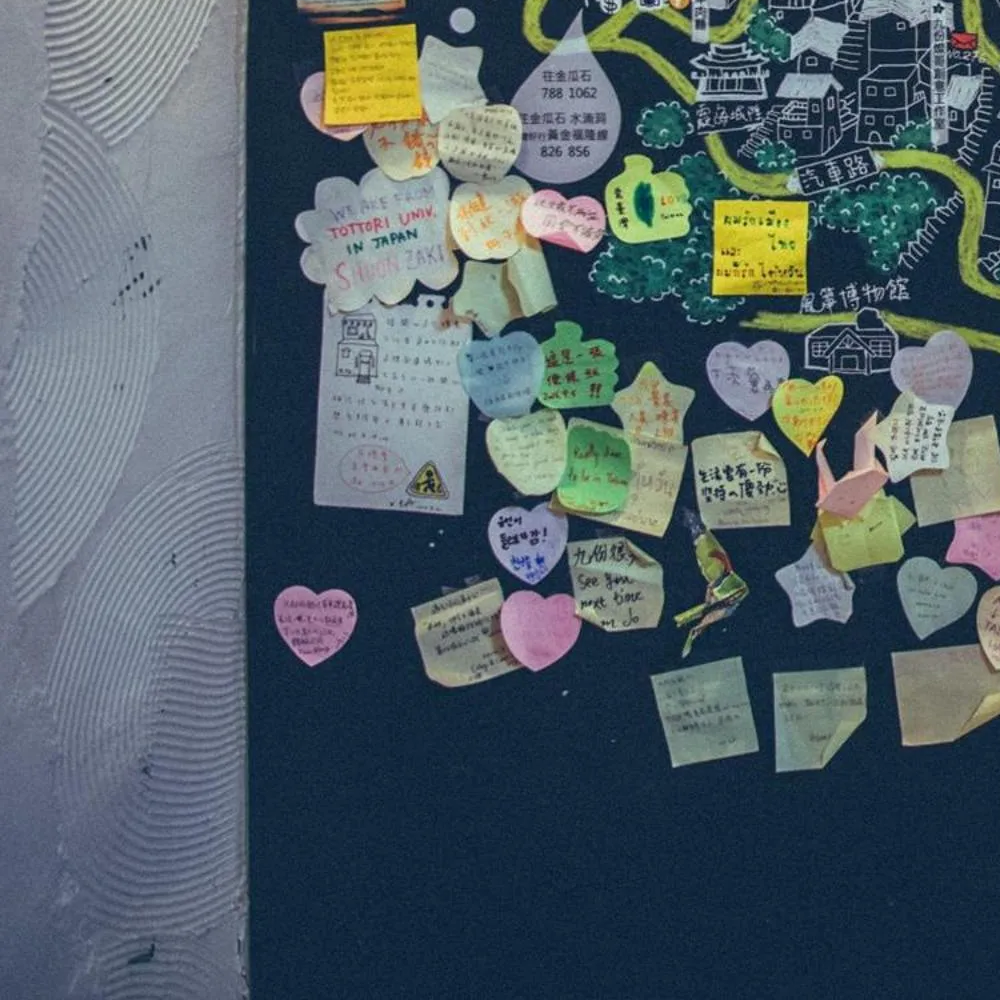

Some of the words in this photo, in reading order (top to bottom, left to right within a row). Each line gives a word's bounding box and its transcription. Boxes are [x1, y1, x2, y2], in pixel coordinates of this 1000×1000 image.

[542, 87, 564, 99] 788
[569, 87, 598, 99] 1062
[541, 146, 563, 158] 826
[568, 146, 590, 158] 856
[802, 153, 869, 190] 汽車路
[327, 215, 389, 239] TOTTORI
[347, 243, 363, 256] IN
[373, 229, 418, 249] JAPAN
